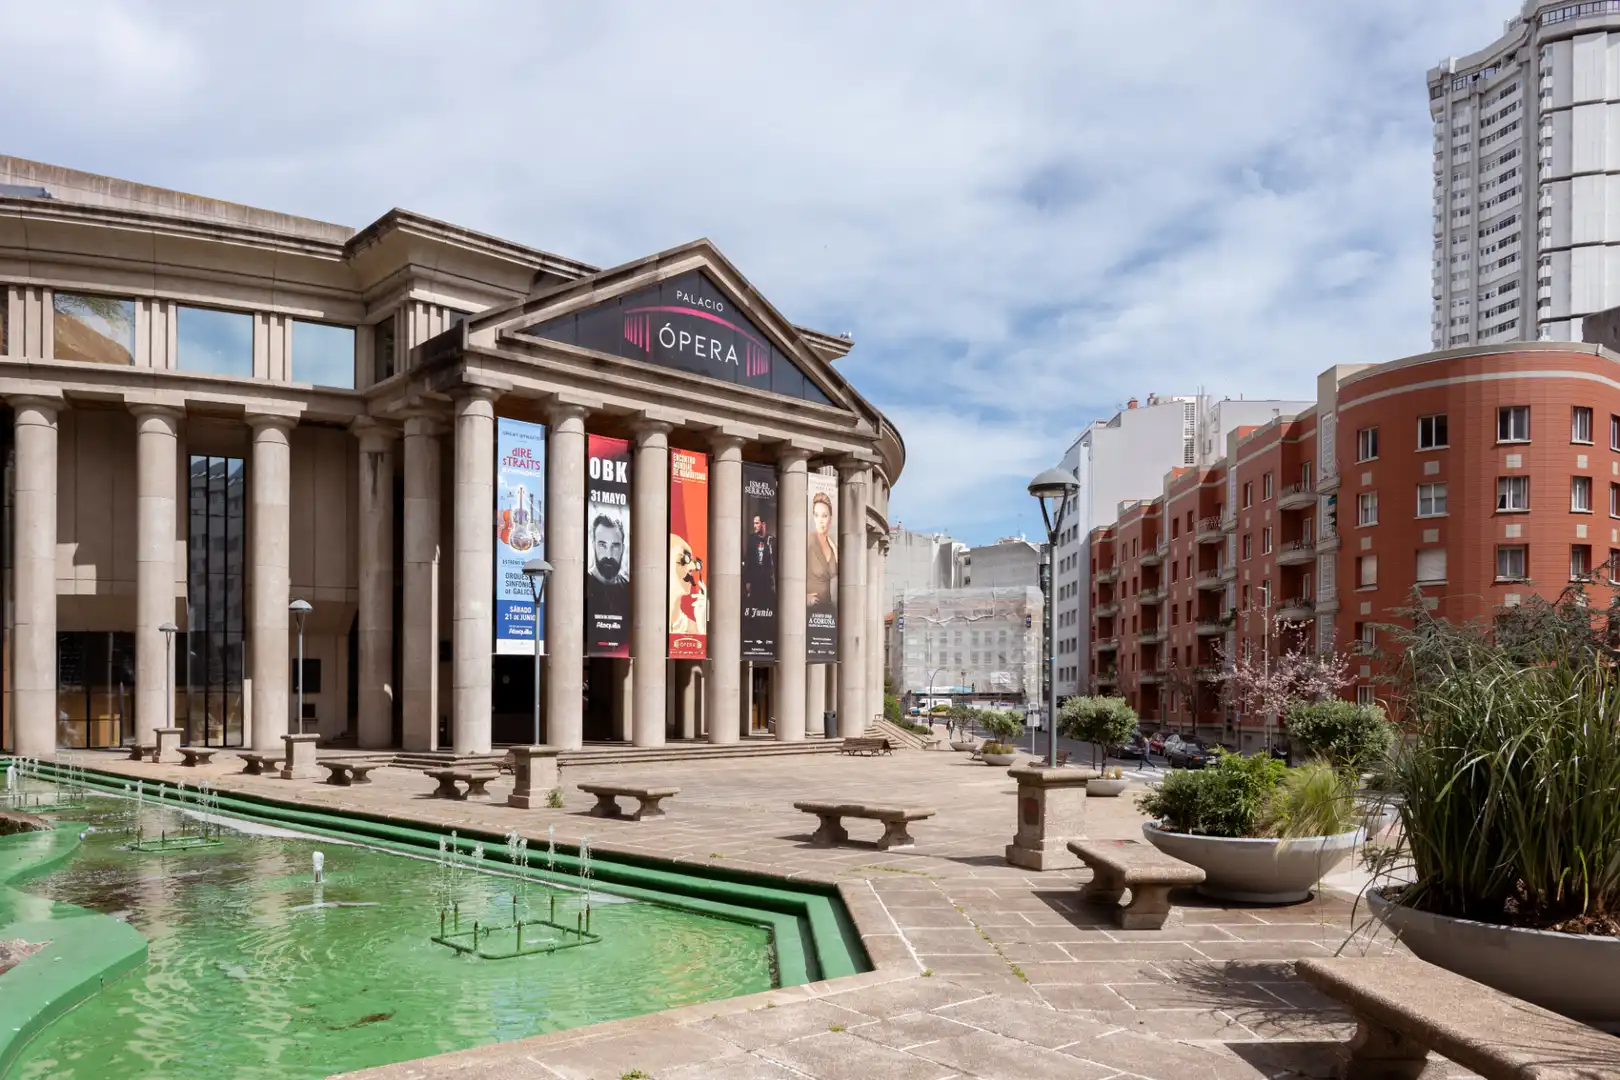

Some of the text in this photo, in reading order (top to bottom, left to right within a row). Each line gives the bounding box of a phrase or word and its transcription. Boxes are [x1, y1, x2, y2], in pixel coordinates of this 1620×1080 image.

[676, 290, 724, 312] PALACIO
[658, 322, 739, 366] ÓPERA
[589, 456, 628, 484] OBK
[744, 486, 775, 497] SERRANO
[590, 489, 627, 506] 31 MAYO
[505, 572, 536, 581] ORQUESA
[513, 588, 533, 596] GALICI
[510, 606, 532, 614] SÁBADO
[744, 608, 773, 618] 8 Junio
